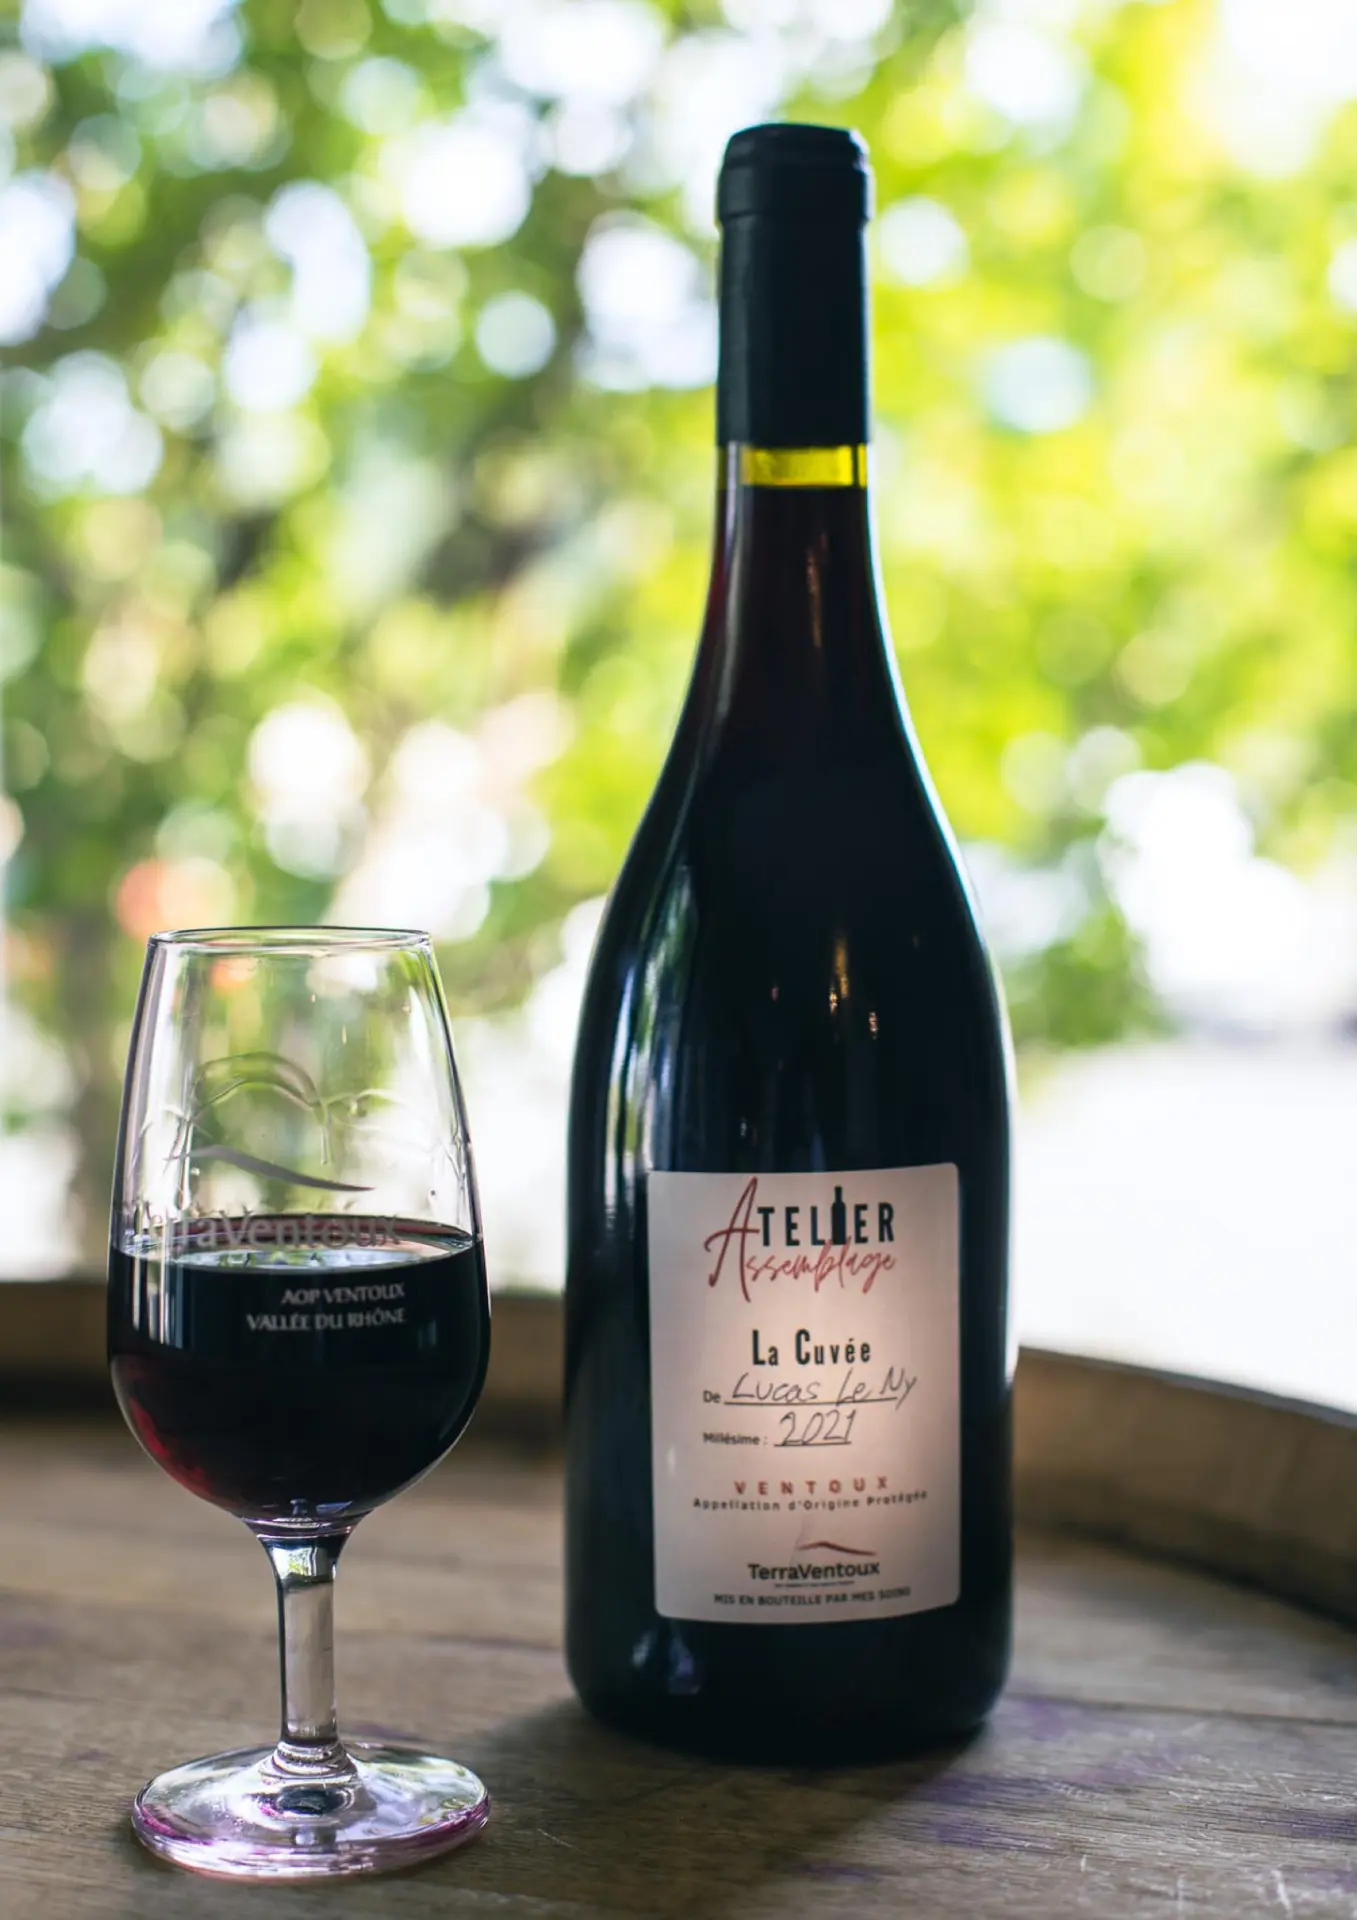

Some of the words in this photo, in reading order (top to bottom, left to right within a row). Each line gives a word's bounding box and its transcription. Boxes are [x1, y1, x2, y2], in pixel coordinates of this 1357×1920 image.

[704, 1177, 895, 1303] ATELIER
[281, 1288, 320, 1304] AOP
[324, 1283, 405, 1303] VENTOUX
[314, 1313, 342, 1330] DU
[347, 1307, 406, 1328] RHÔNE
[752, 1329, 779, 1366] La
[795, 1329, 871, 1366] Cuvée
[702, 1389, 721, 1402] De
[732, 1372, 821, 1403] Lucas
[779, 1409, 857, 1446] 2021
[734, 1476, 888, 1495] VENTOUX
[693, 1498, 781, 1512] Appellation
[747, 1562, 880, 1581] TerraVentoux
